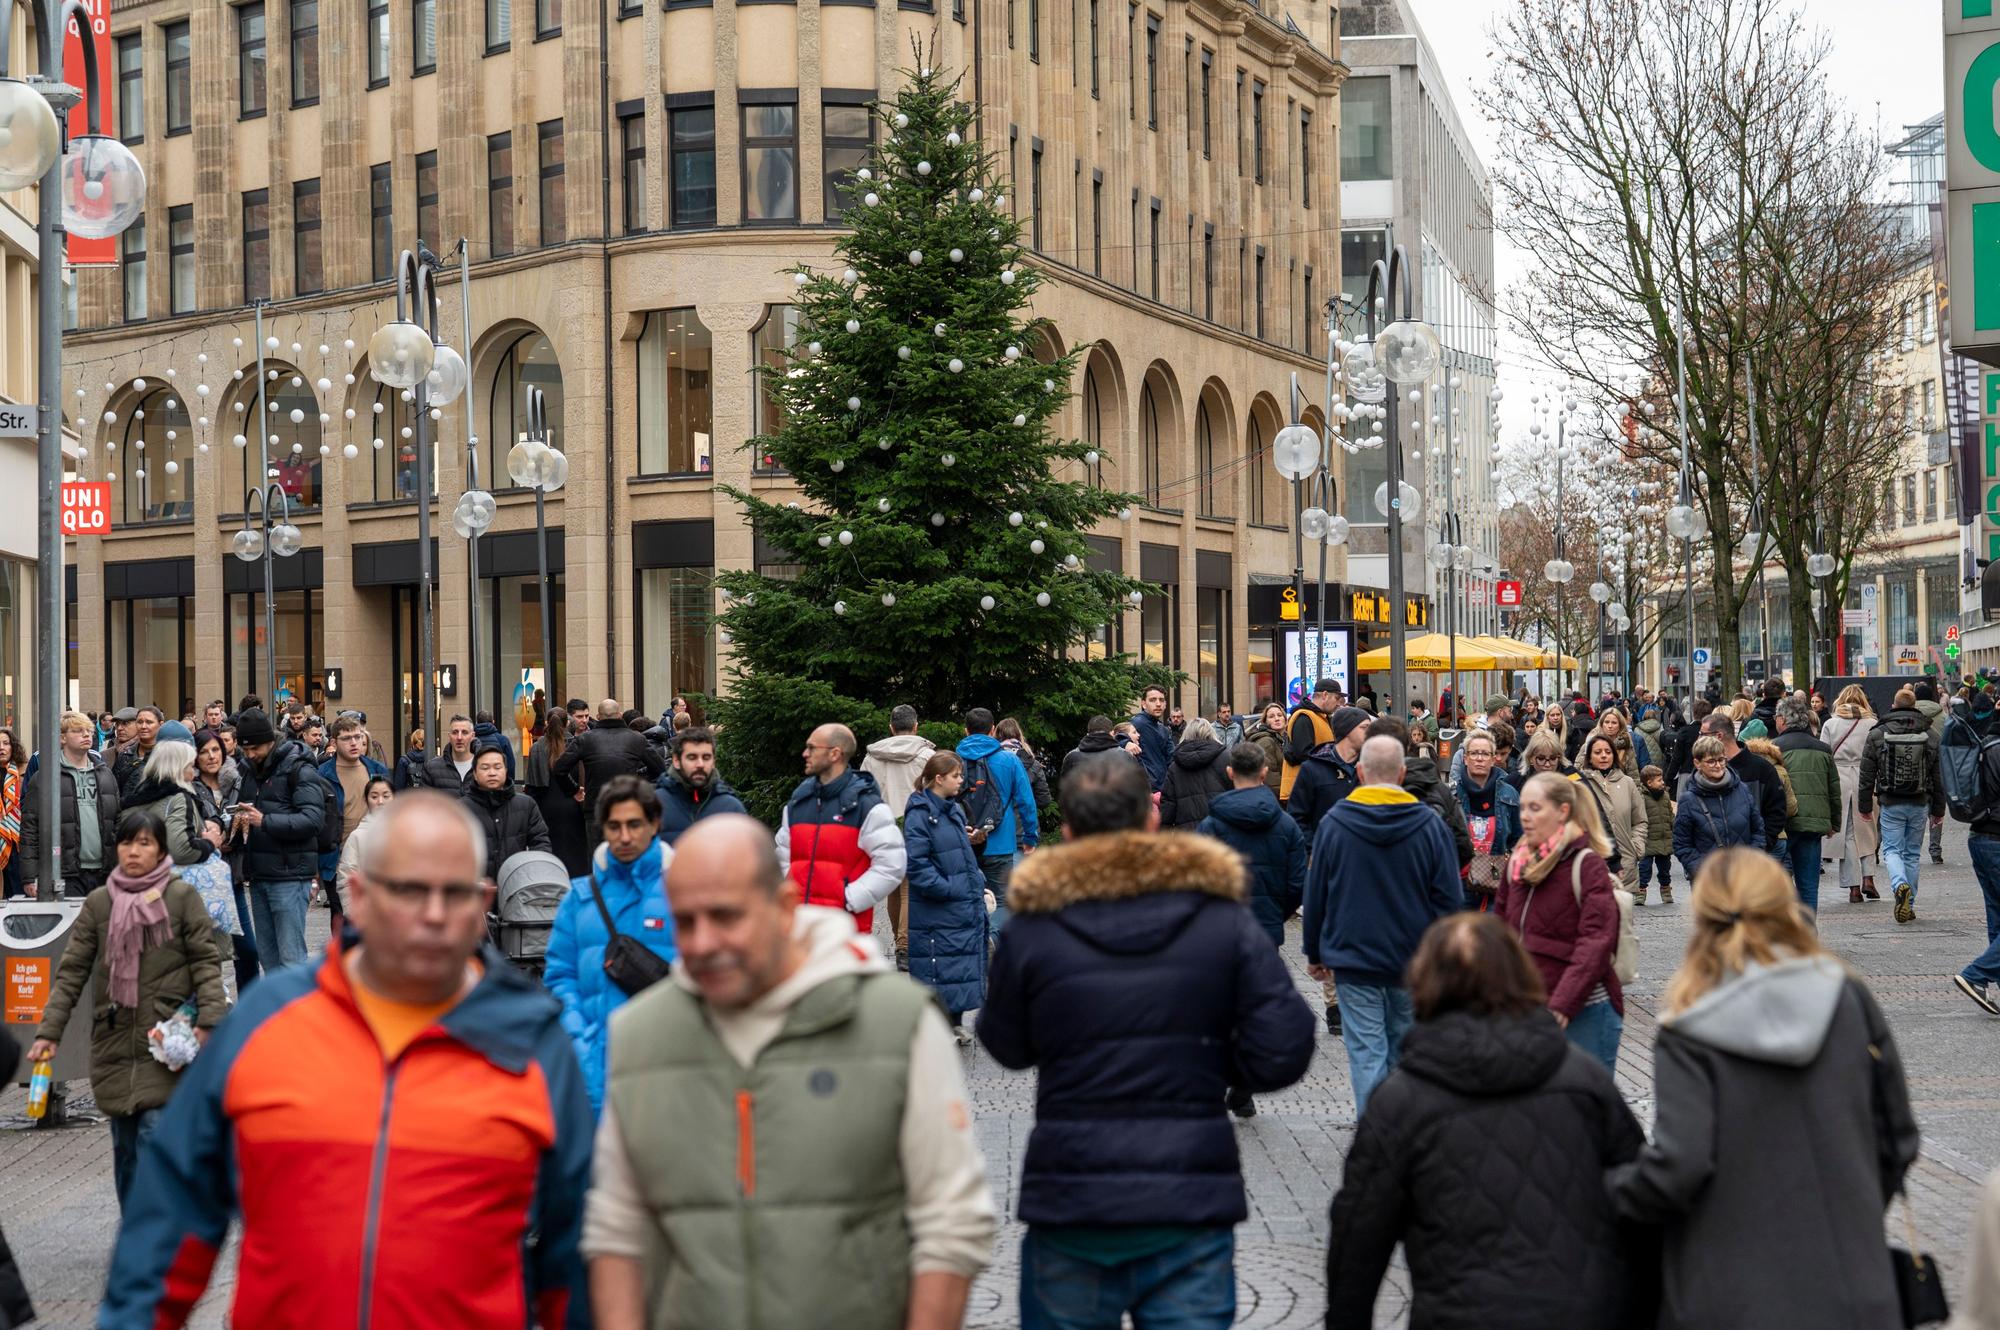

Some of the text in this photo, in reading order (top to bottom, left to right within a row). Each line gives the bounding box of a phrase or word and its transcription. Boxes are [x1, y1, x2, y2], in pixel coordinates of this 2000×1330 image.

[68, 17, 106, 38] QO
[0, 412, 28, 429] Str.
[63, 488, 101, 507] UNI
[63, 509, 104, 531] QLO
[1900, 648, 1917, 659] dm
[1904, 746, 1913, 780] NORTH
